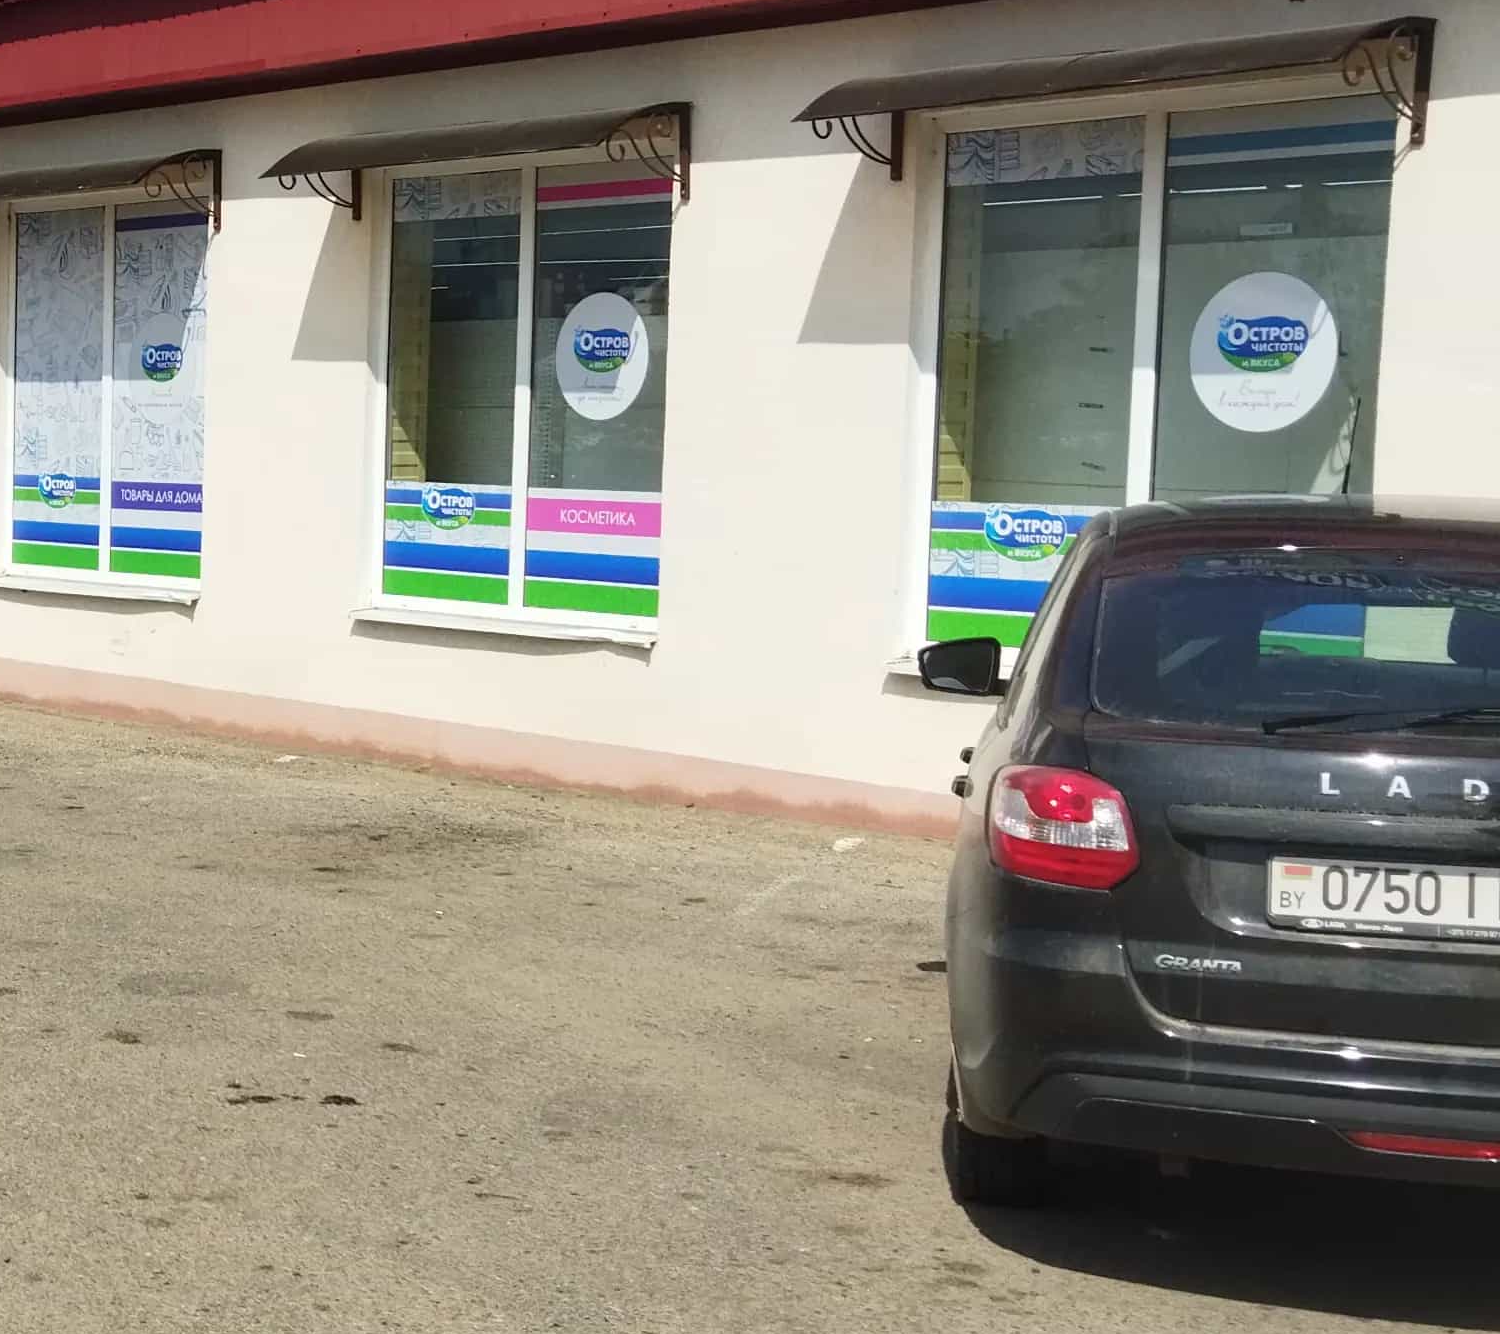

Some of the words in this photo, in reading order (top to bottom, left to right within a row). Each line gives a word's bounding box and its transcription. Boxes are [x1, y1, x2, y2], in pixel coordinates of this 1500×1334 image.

[1251, 342, 1304, 352] ЧИСТОТЫ
[120, 488, 153, 502] ТОВАРЫ
[155, 491, 173, 504] ДЛЯ
[560, 508, 637, 526] КОСМЕТИКА
[1320, 771, 1490, 802] LAD
[1279, 890, 1305, 909] BY
[1322, 865, 1442, 917] 0750
[1155, 953, 1242, 972] GRANTA
